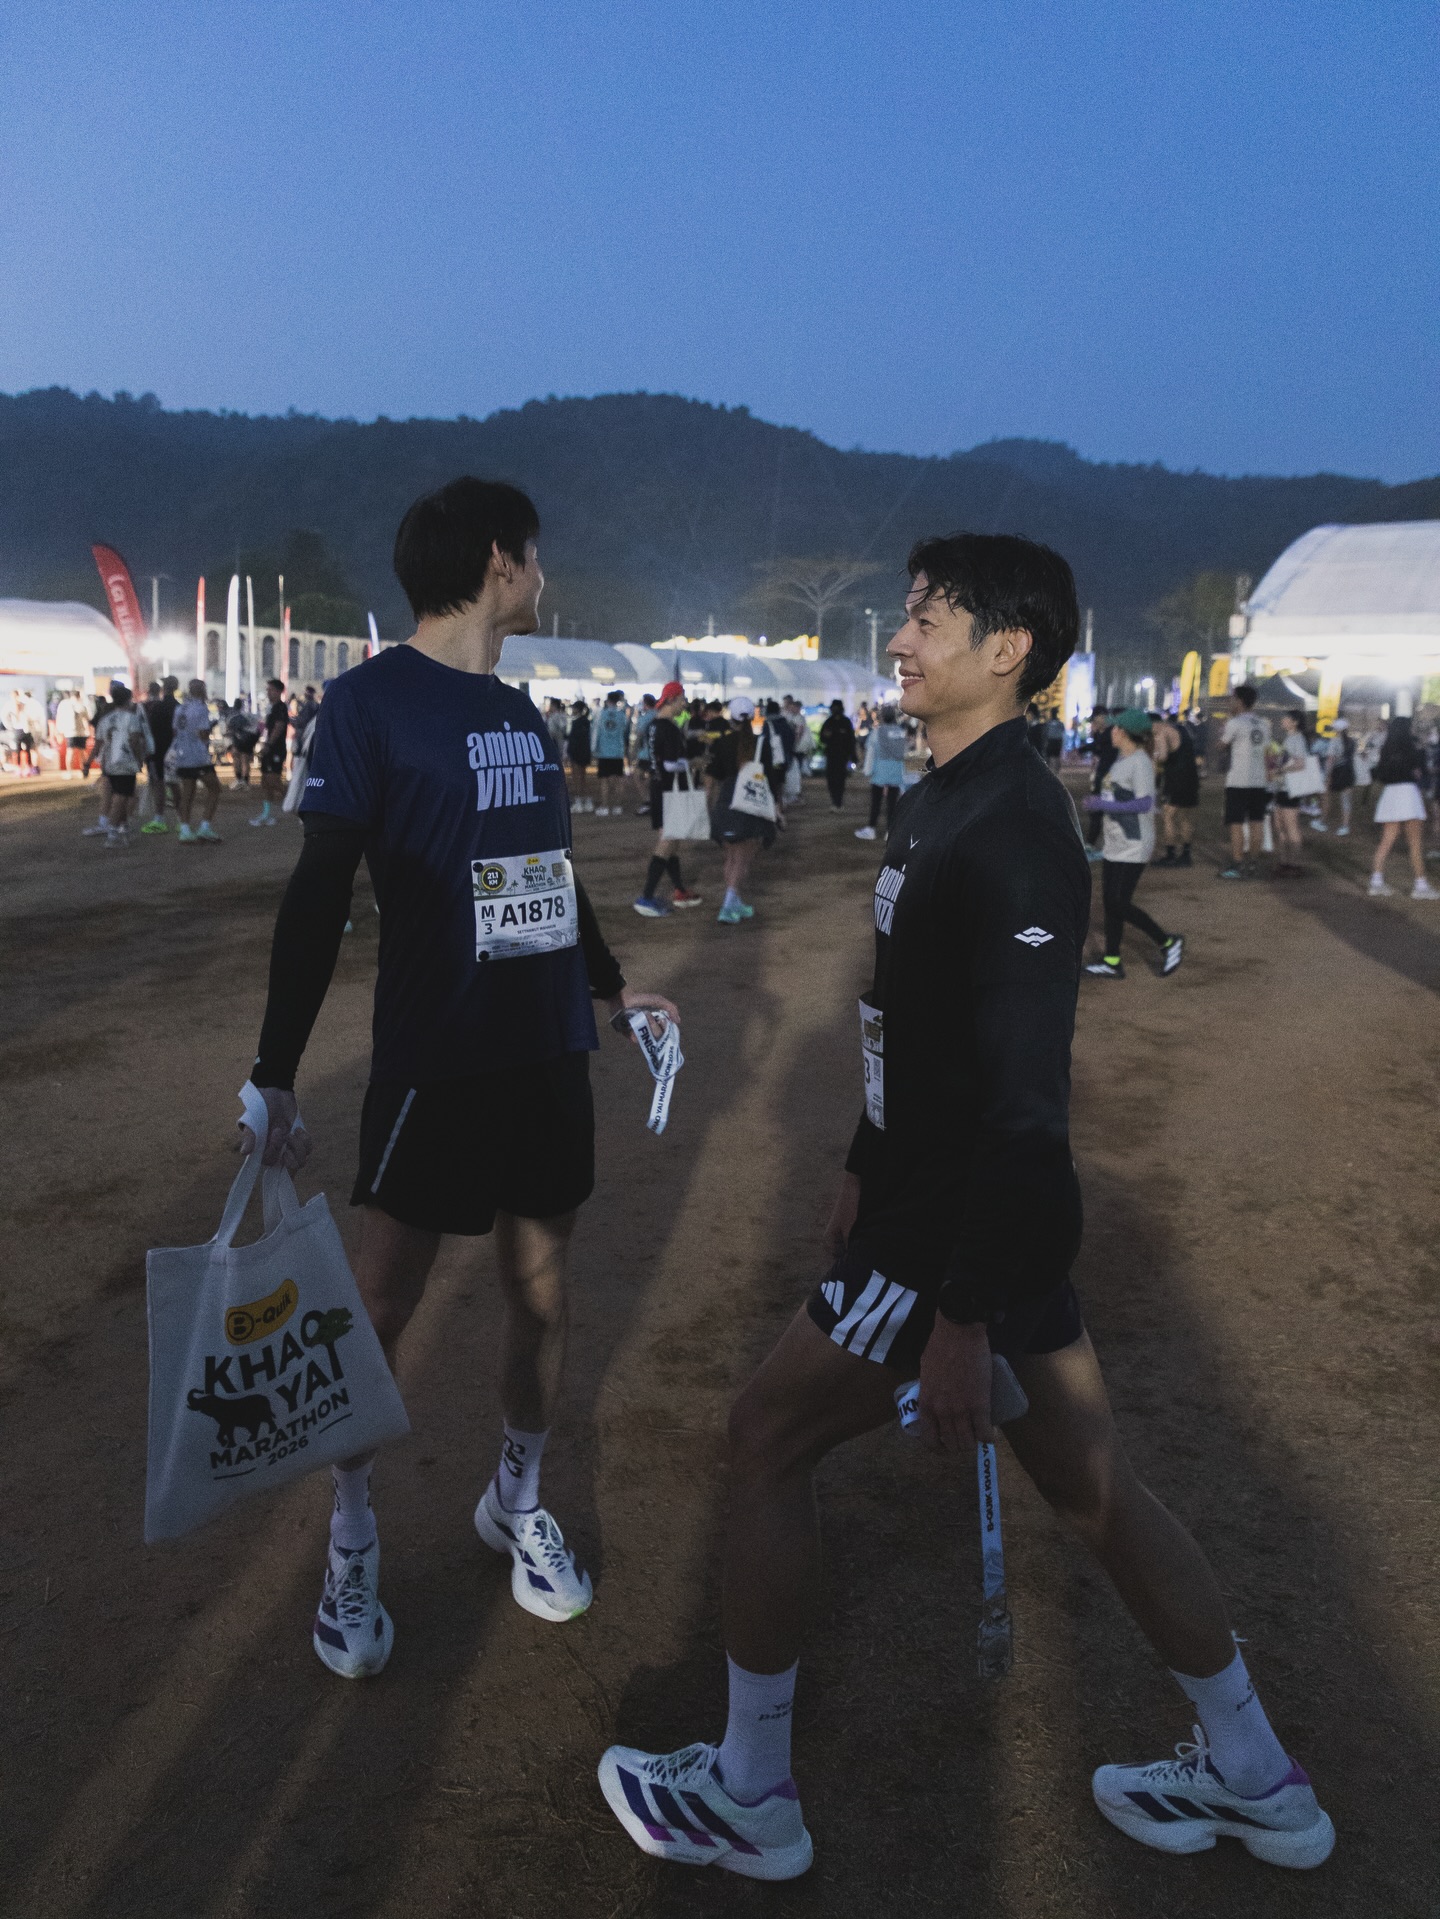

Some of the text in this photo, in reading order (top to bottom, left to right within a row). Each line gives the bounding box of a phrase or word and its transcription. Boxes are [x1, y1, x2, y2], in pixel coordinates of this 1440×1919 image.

[467, 721, 545, 769] amino
[477, 765, 539, 811] VITAL
[481, 904, 496, 919] M
[484, 922, 493, 935] 3
[500, 895, 565, 928] A1878
[205, 1310, 328, 1394] KHAO
[275, 1341, 345, 1413] YAI
[210, 1387, 350, 1469] MARATHON
[268, 1436, 309, 1466] 2026
[983, 1458, 992, 1491] KHAO
[984, 1491, 995, 1533] B-QUIK
